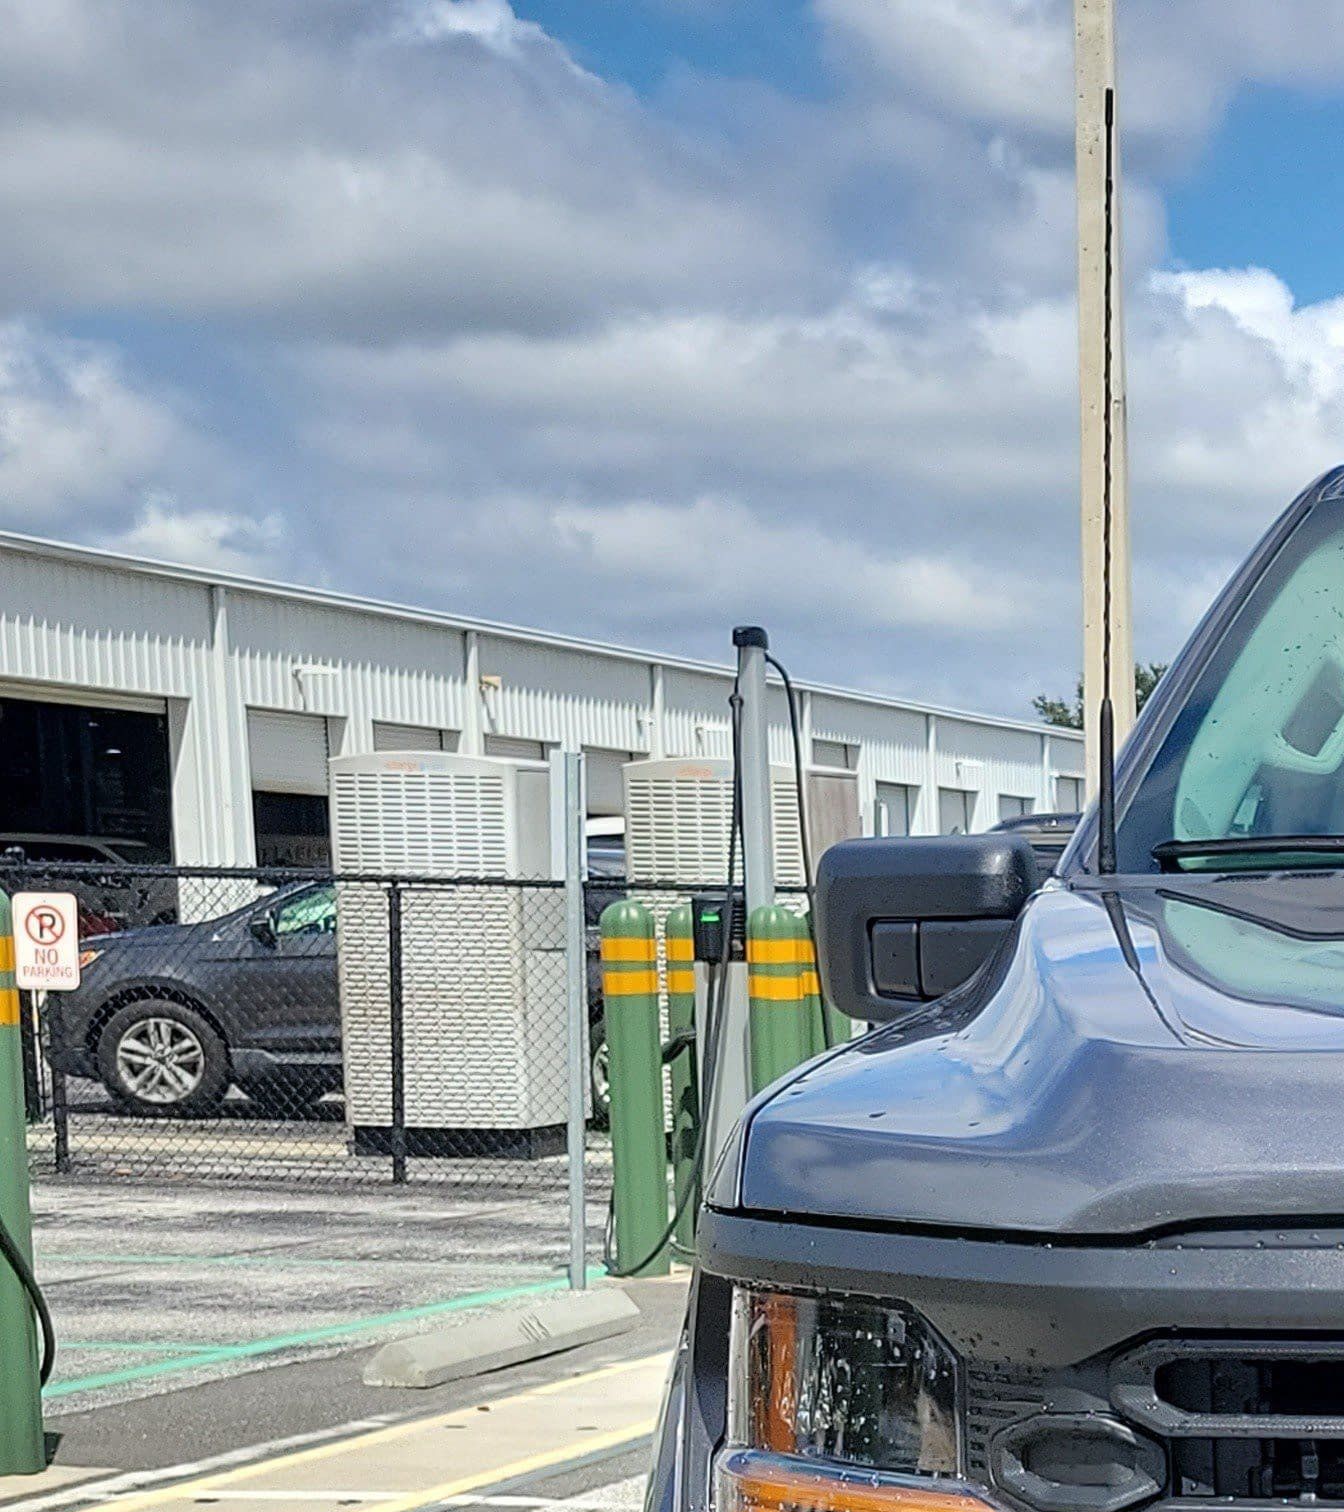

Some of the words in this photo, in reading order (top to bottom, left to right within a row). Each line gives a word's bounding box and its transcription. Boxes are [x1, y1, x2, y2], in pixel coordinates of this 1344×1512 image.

[39, 913, 56, 938] P
[35, 948, 59, 965] NO
[23, 966, 73, 978] PARKING
